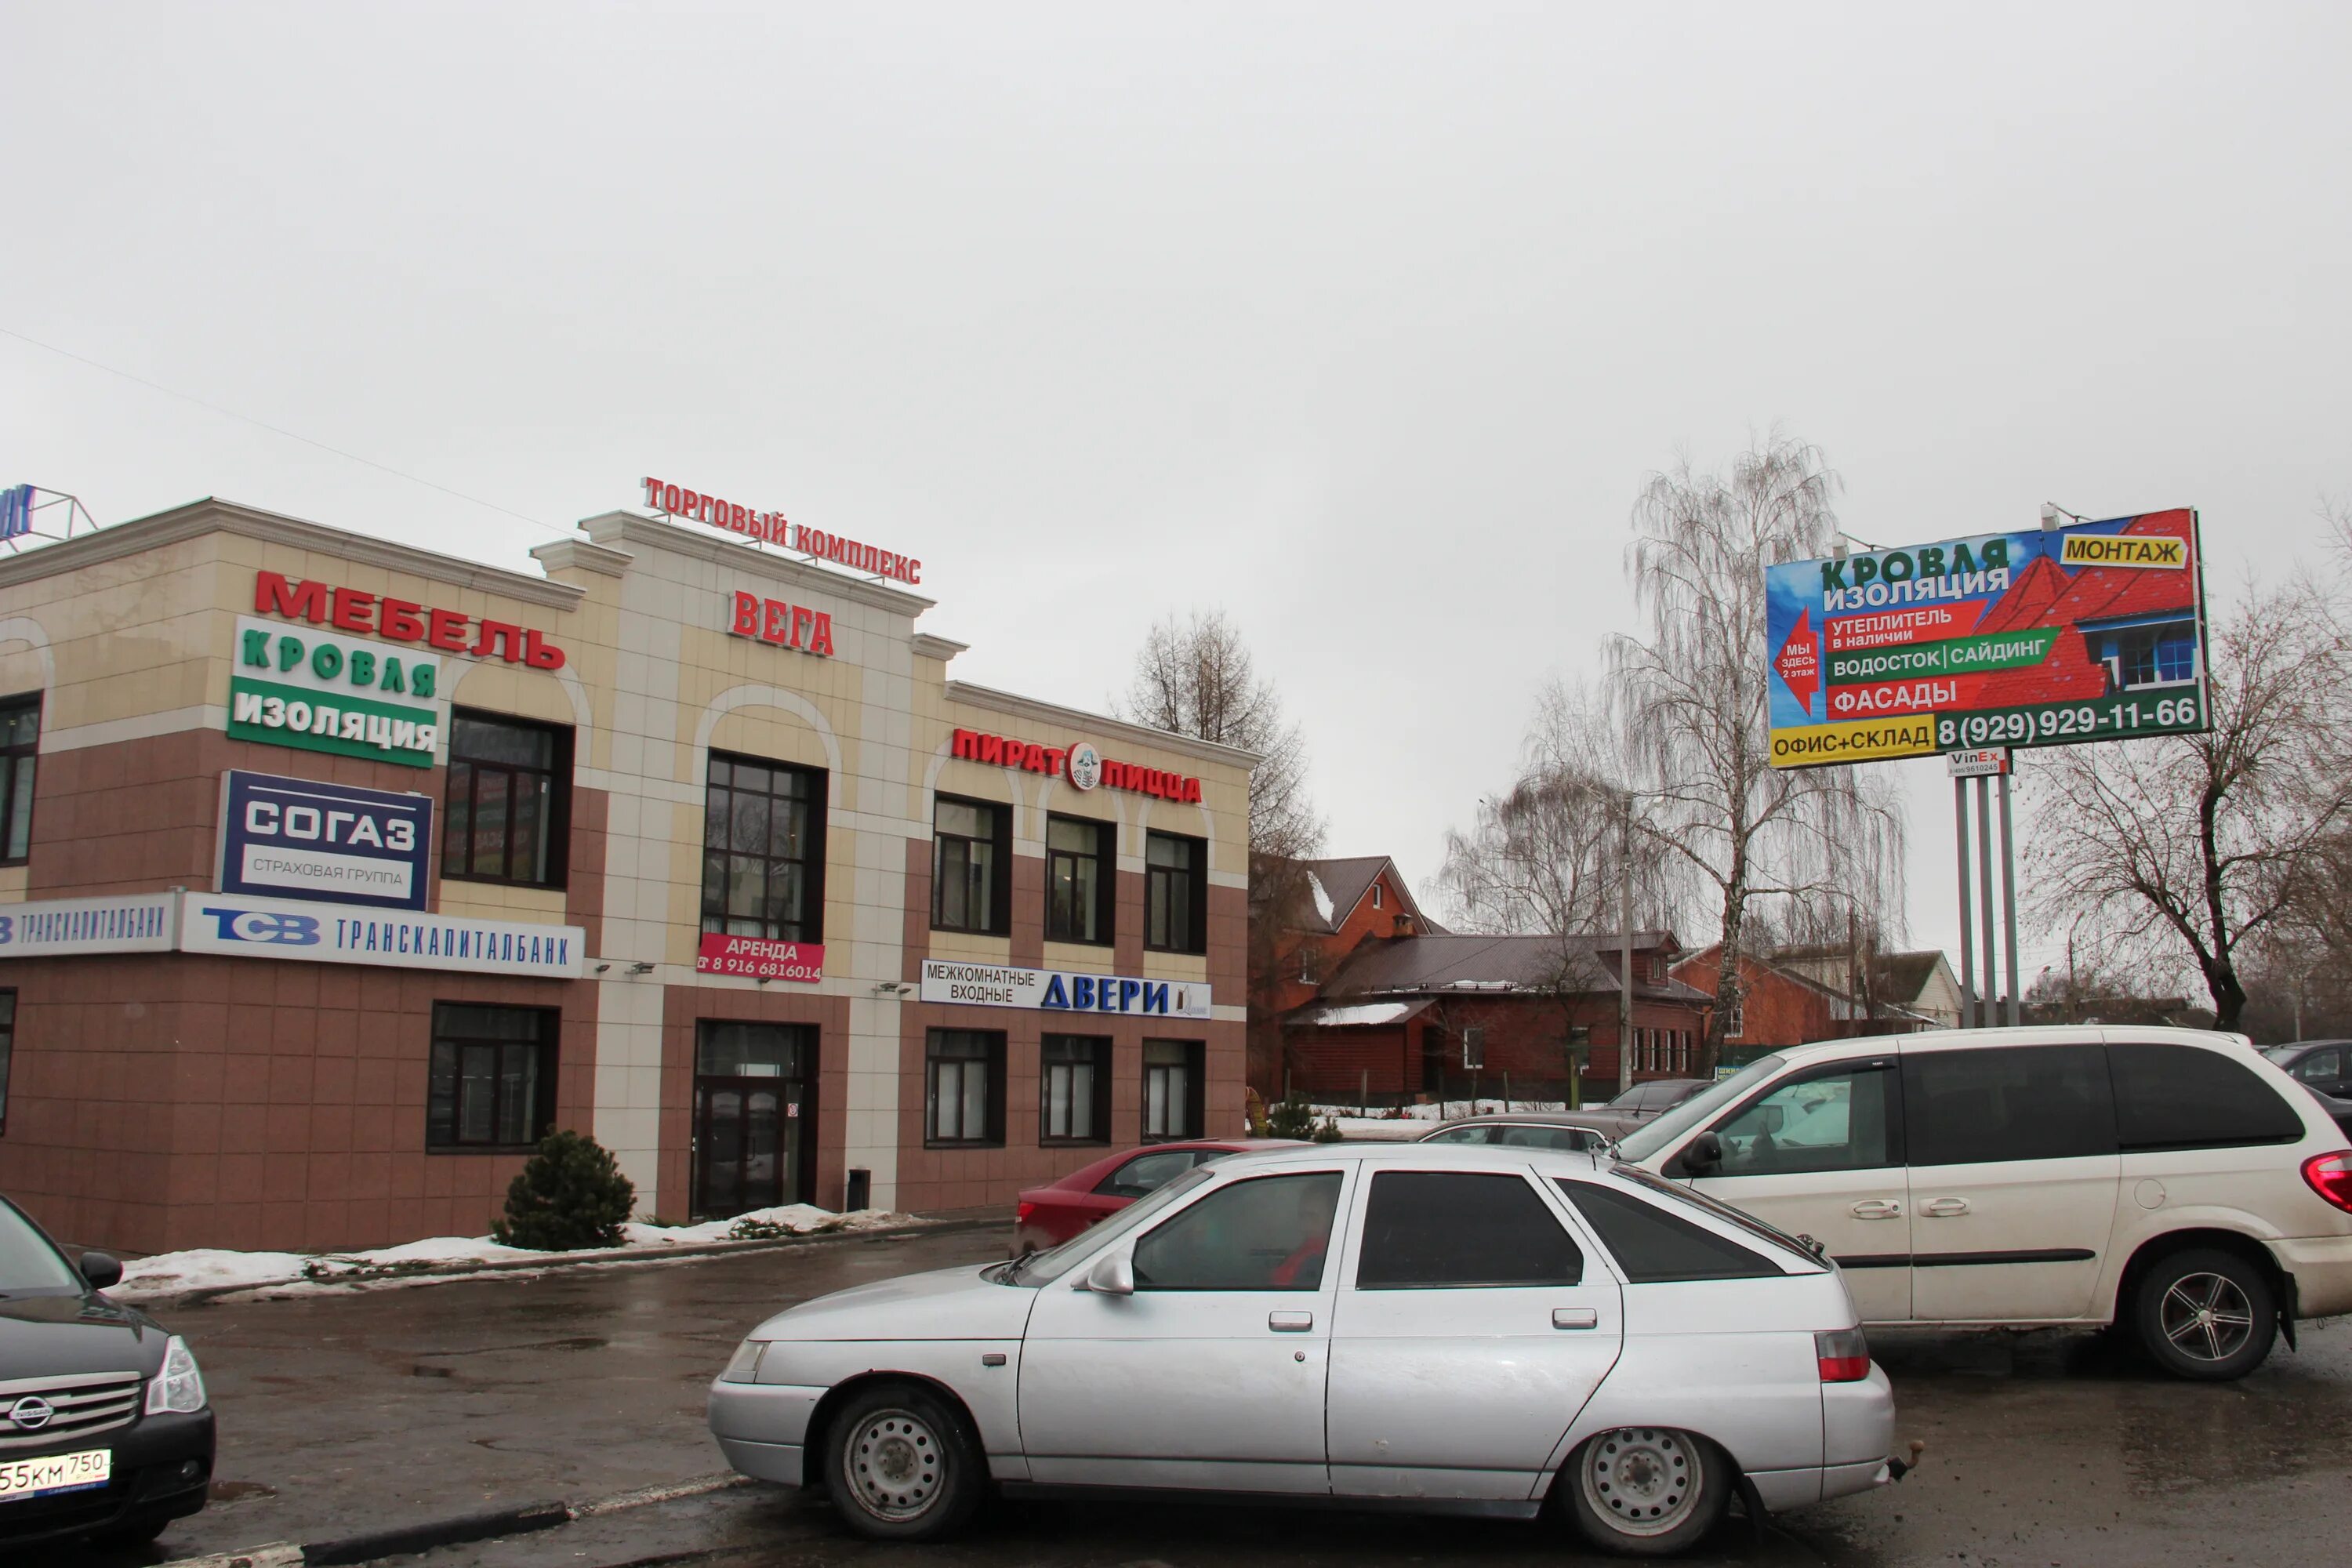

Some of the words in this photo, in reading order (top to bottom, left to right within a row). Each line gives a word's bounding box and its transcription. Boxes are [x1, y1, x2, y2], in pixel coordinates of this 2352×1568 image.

[641, 476, 787, 544] ТОРГОВЫЙ
[792, 523, 921, 585] КОМПЛЕКС
[1820, 538, 2010, 591] КРОВЛЯ
[2066, 539, 2180, 563] МОНТАЖ
[1824, 567, 2009, 612] ИЗОЛЯЦИЯ
[255, 570, 566, 670] МЕБЕЛЬ
[727, 590, 834, 658] ВЕГА
[1832, 609, 1952, 637] УТЕПЛИТЕЛЬ
[1787, 643, 1810, 656] МЫ
[1833, 639, 1842, 648] в
[1846, 630, 1913, 647] наличии
[243, 629, 437, 698] КРОВЛЯ
[1782, 655, 1816, 668] ЗДЕСЬ
[1834, 650, 1940, 677] ВОДОСТОК
[1951, 638, 2045, 665] САЙДИНГ
[1783, 670, 1790, 678] 2
[1791, 668, 1815, 677] этаж
[1835, 681, 1956, 712] ФАСАДЫ
[235, 691, 437, 753] ИЗОЛЯЦИЯ
[1774, 726, 1929, 756] ОФИС+СКЛАД
[952, 728, 1065, 775] ПИРАТ
[1101, 759, 1202, 804] ПИЦЦА
[1951, 752, 1998, 764] VinEx
[1966, 764, 1998, 772] 9610245
[245, 800, 415, 851] СОГАЗ
[252, 858, 343, 880] СТРАХОВАЯ
[347, 868, 403, 886] ГРУППА
[21, 907, 165, 943] ТРАНСКАПИТАЛБАНК
[337, 918, 568, 966] ТРАНСКАПИТАЛБАНК
[726, 939, 798, 961] АРЕНДА
[713, 957, 721, 971] 8
[728, 959, 755, 973] 916
[759, 962, 822, 979] 6816014
[927, 964, 1035, 986] МЕЖКОМНАТНЫЕ
[950, 985, 1013, 1003] ВХОДНЫЕ
[1040, 974, 1168, 1014] ДВЕРИ
[70, 1454, 103, 1474] 750
